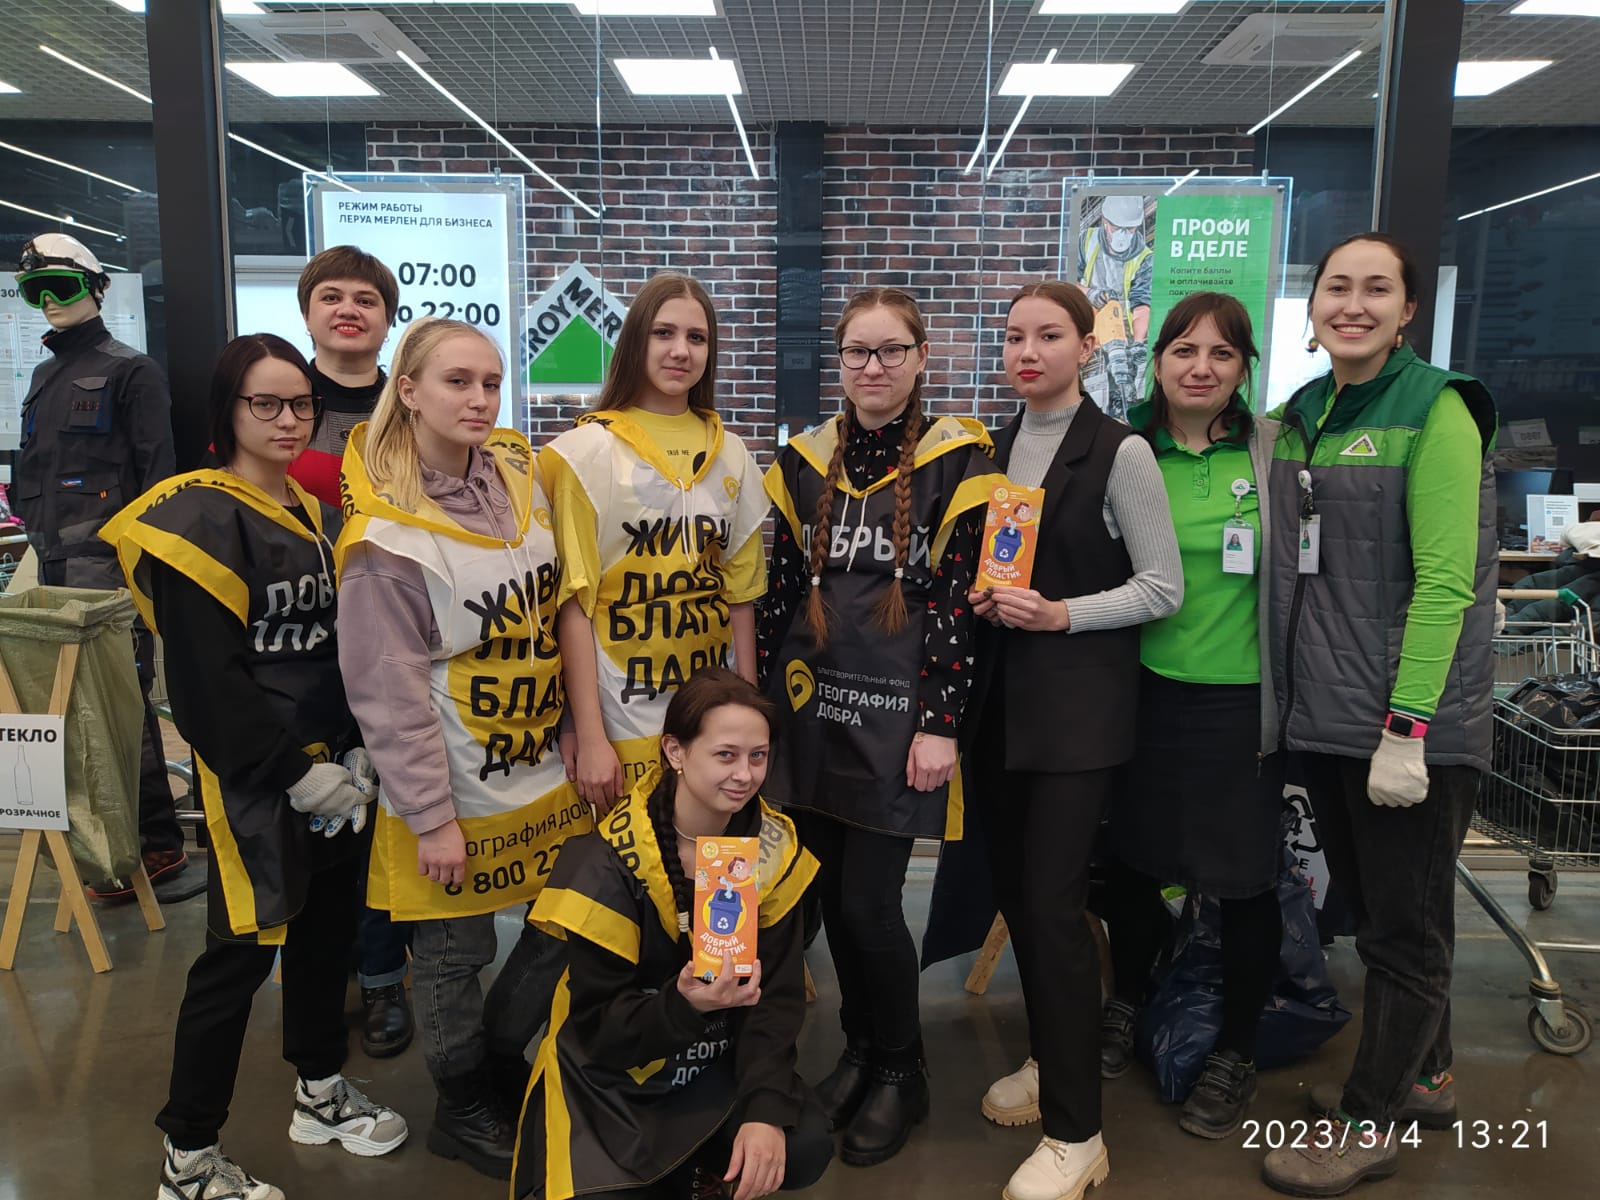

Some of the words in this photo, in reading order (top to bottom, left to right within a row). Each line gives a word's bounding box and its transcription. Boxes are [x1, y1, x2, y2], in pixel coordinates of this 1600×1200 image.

[338, 201, 378, 212] РЕЖИМ
[380, 203, 423, 213] РАБОТЫ
[339, 214, 372, 224] ЛЕРУА
[374, 215, 418, 225] МЕРЛЕН
[419, 217, 443, 227] ДЛЯ
[444, 217, 493, 228] БИЗНЕСА
[1171, 218, 1250, 236] ПРОФИ
[1170, 240, 1183, 258] В
[1187, 240, 1248, 261] ДЕЛЕ
[399, 262, 476, 288] 07:00
[1170, 266, 1202, 274] Копите
[1203, 266, 1232, 274] баллы
[563, 276, 623, 344] MER
[802, 523, 931, 569] ДБРЫЙ
[983, 558, 1016, 573] ДОБРЫЙ
[986, 567, 1022, 580] ПЛАСТИК
[264, 570, 337, 618] ДОБ
[463, 557, 560, 642] ЖИВ
[608, 594, 731, 641] БЛАГО
[888, 679, 911, 689] ФОНД
[470, 675, 563, 718] БЛА
[817, 682, 910, 713] ГЕОГРАФИЯ
[816, 701, 863, 727] ДОБРА
[479, 726, 559, 782] ДАР
[473, 860, 526, 894] 800
[699, 932, 740, 948] ДОБРЫЙ
[703, 942, 748, 958] ПЛАТИК
[675, 1039, 730, 1061] ЕОГР
[671, 1065, 709, 1087] ДО
